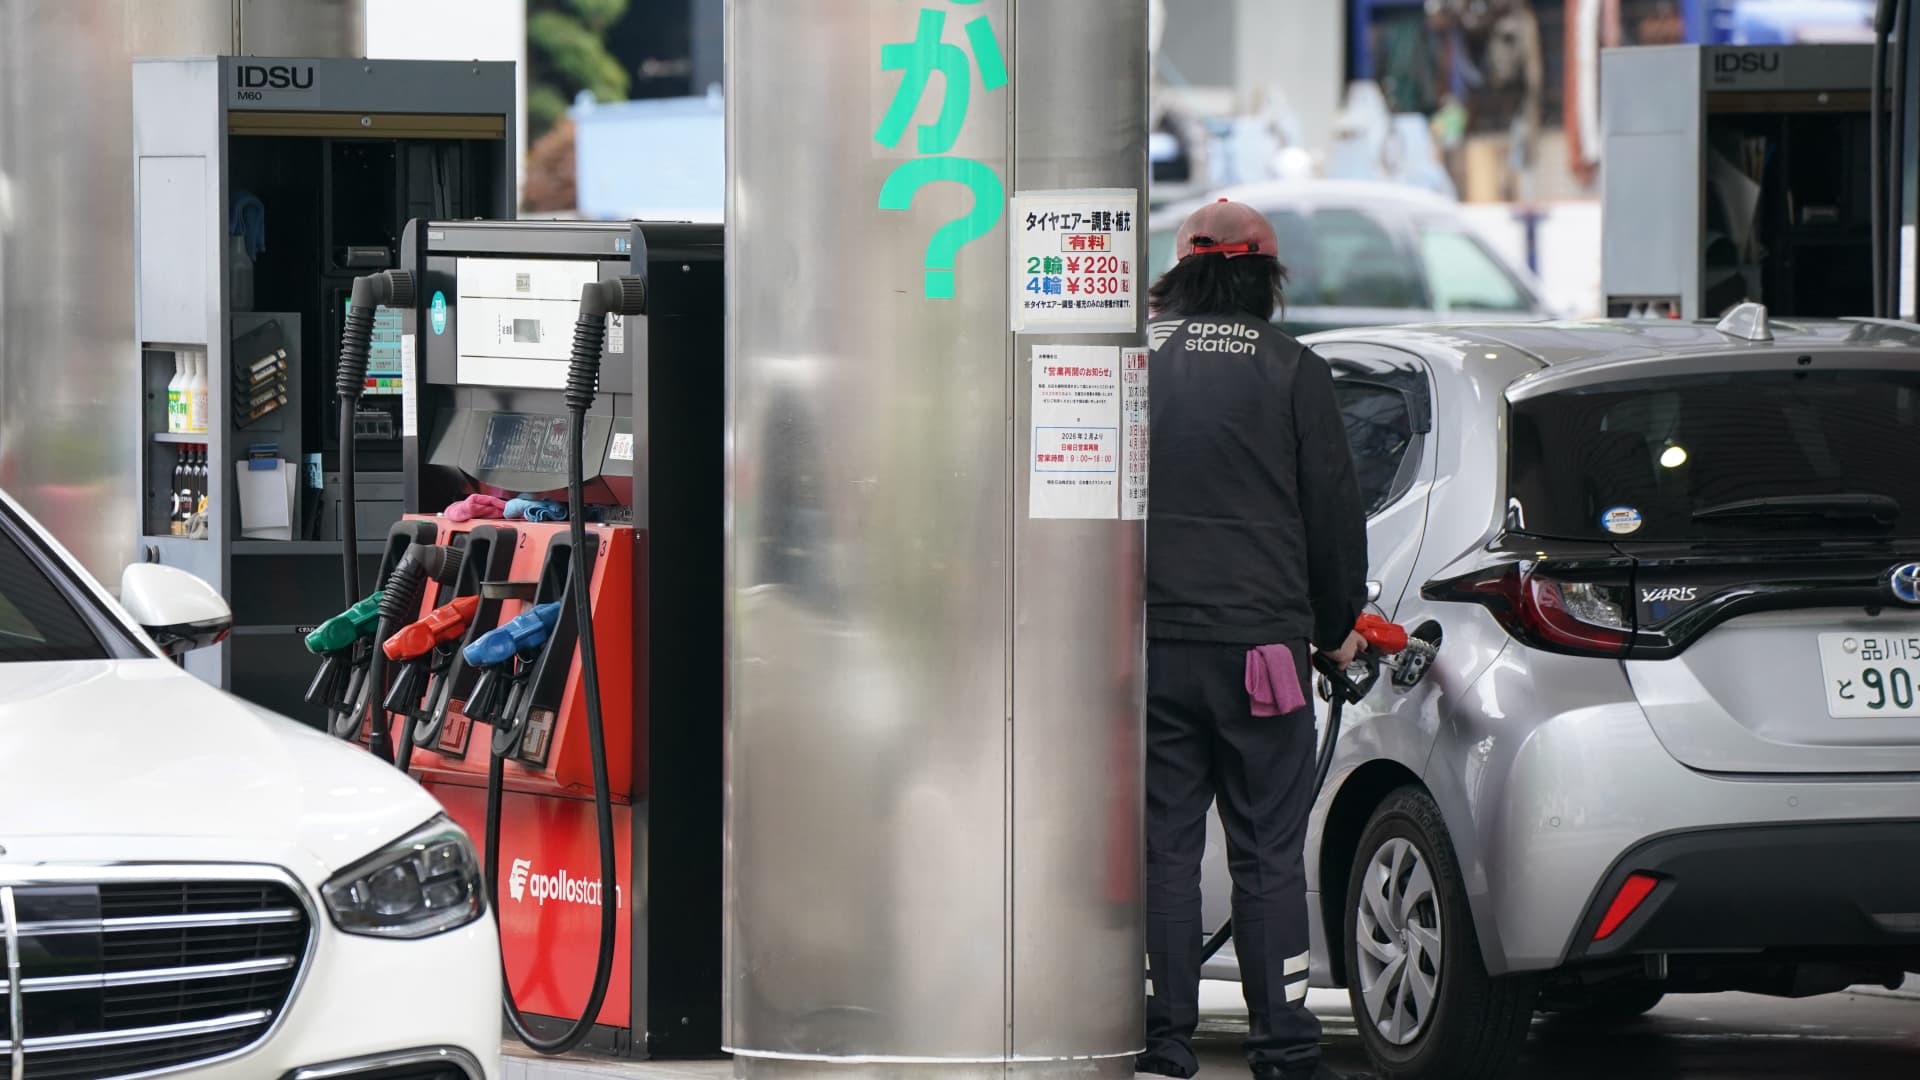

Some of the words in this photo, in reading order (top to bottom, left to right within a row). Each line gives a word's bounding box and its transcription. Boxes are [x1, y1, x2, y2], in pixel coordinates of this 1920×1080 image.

[1714, 52, 1779, 73] IDSU
[237, 66, 314, 89] IDSU
[237, 91, 262, 100] M60
[873, 0, 1008, 299] か？
[1026, 210, 1131, 232] タイヤエアー調整・補充
[1068, 235, 1105, 251] 有料
[1187, 323, 1259, 340] apollo
[1185, 337, 1256, 355] station
[520, 533, 527, 549] 2
[600, 540, 607, 557] 3
[1641, 586, 1698, 603] YARIS
[1862, 667, 1920, 709] 90
[530, 869, 621, 909] apollostatn
